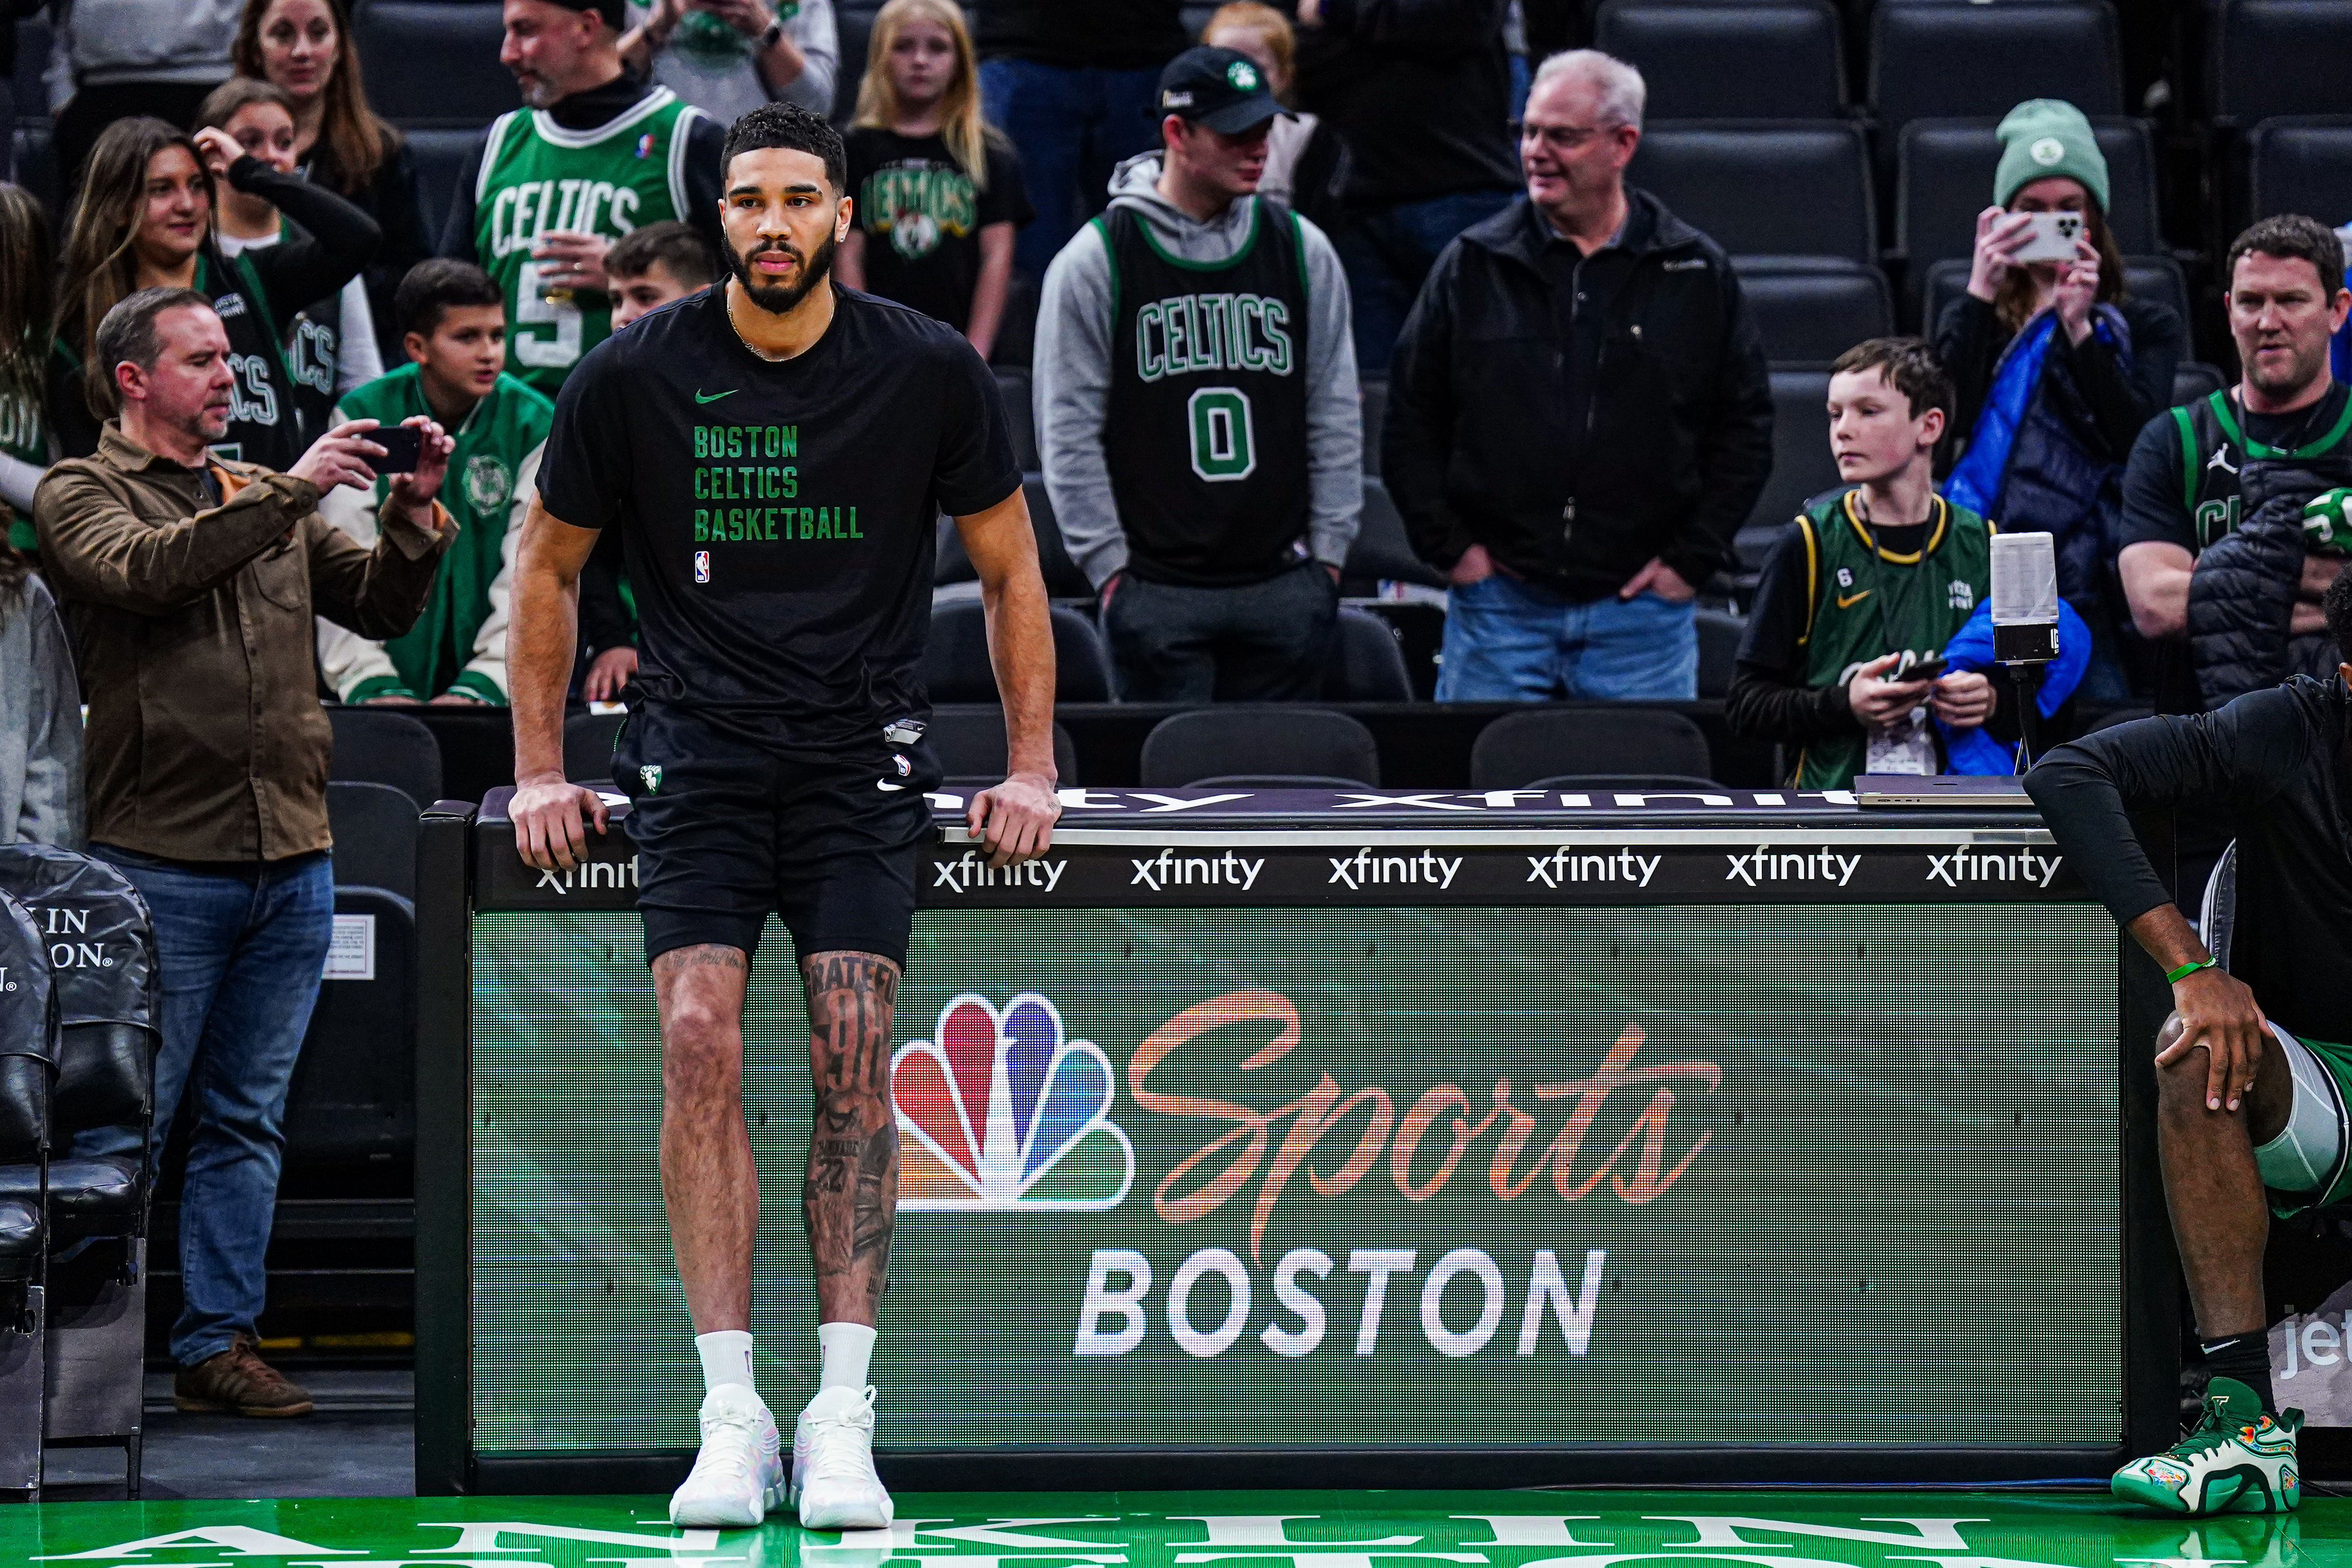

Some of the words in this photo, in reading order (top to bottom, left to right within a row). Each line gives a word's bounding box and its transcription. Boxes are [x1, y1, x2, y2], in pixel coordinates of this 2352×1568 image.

[492, 179, 640, 259] CELTICS
[514, 261, 583, 368] 5
[1137, 294, 1293, 383] CELTICS
[694, 425, 797, 458] BOSTON
[1187, 387, 1258, 482] 0
[694, 466, 797, 499] CELTICS
[694, 506, 863, 541] BASKETBALL
[1332, 789, 1859, 810] xfinit
[933, 850, 1067, 893] xfinity
[1131, 848, 1265, 891] xfinity
[1328, 847, 1464, 890] xfinity
[1527, 846, 1662, 889] xfinity
[1725, 845, 1862, 887] xfinity
[1926, 845, 2063, 887] xfinity
[46, 908, 90, 934] IN
[1128, 989, 1722, 1269] Sports
[1072, 1247, 1607, 1358] BOSTON
